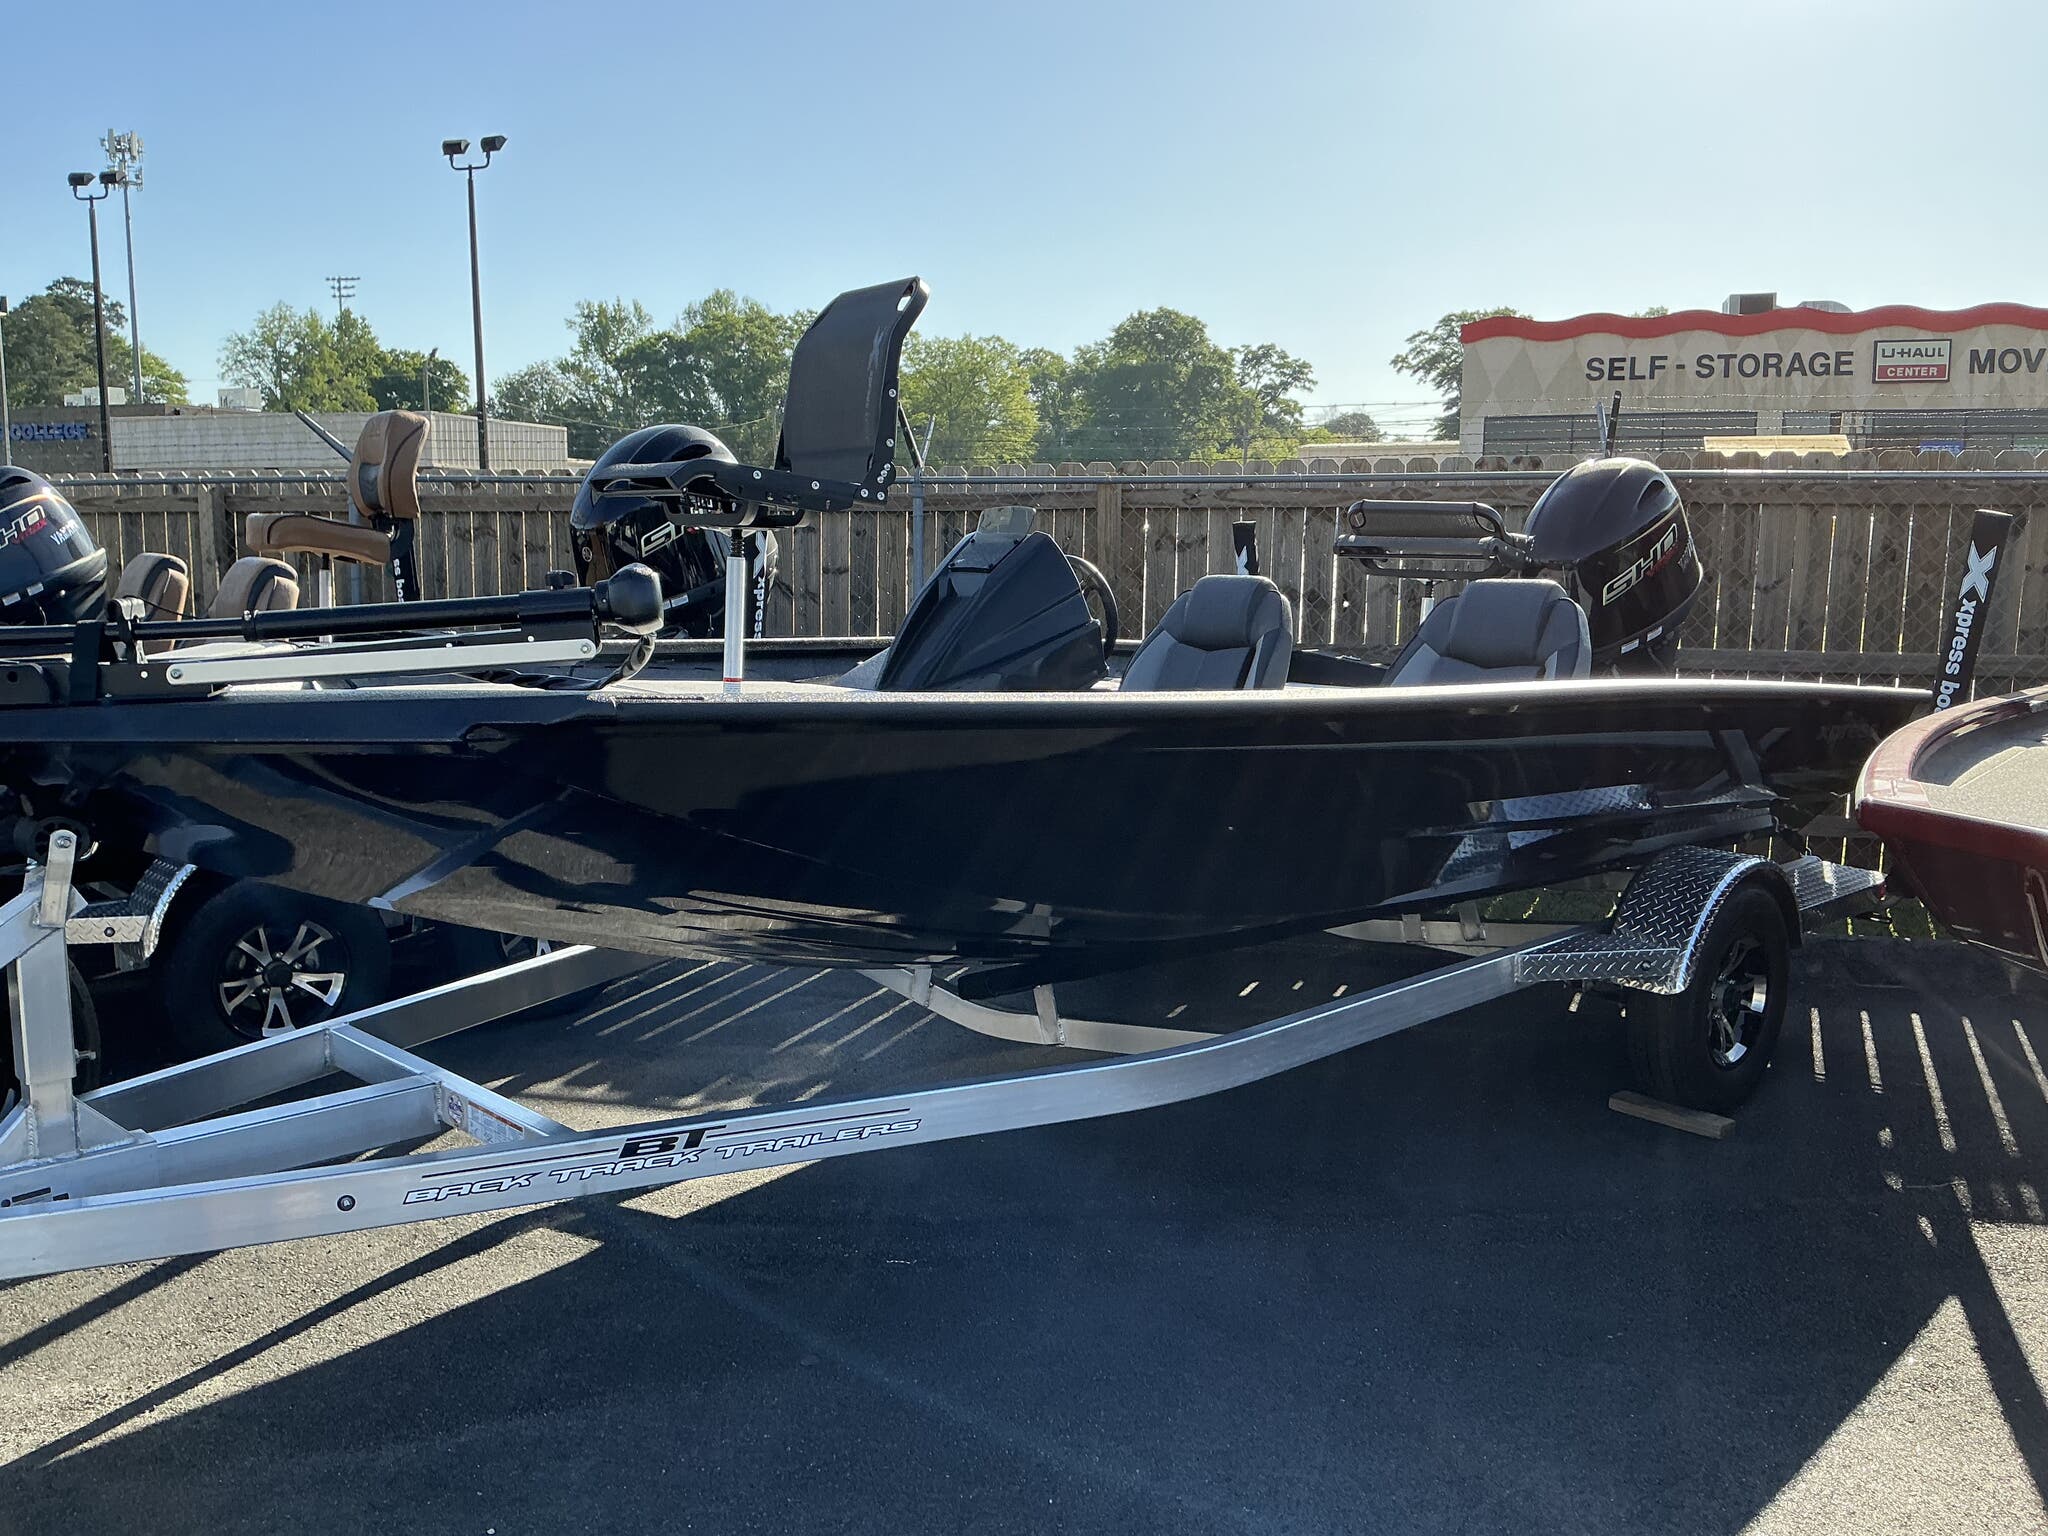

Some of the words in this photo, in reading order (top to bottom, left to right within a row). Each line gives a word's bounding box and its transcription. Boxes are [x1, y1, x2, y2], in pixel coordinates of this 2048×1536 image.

[1585, 356, 1668, 381] SELF
[1695, 351, 1855, 379] STORAGE
[1968, 348, 2048, 375] MOV
[1881, 347, 1945, 358] U-HAUL
[1886, 367, 1938, 377] CENTER
[1945, 598, 1977, 676] xpress
[618, 1124, 727, 1159] BT
[402, 1171, 543, 1204] BACK
[548, 1148, 710, 1184] TRACK
[714, 1119, 922, 1160] TRAILERS
